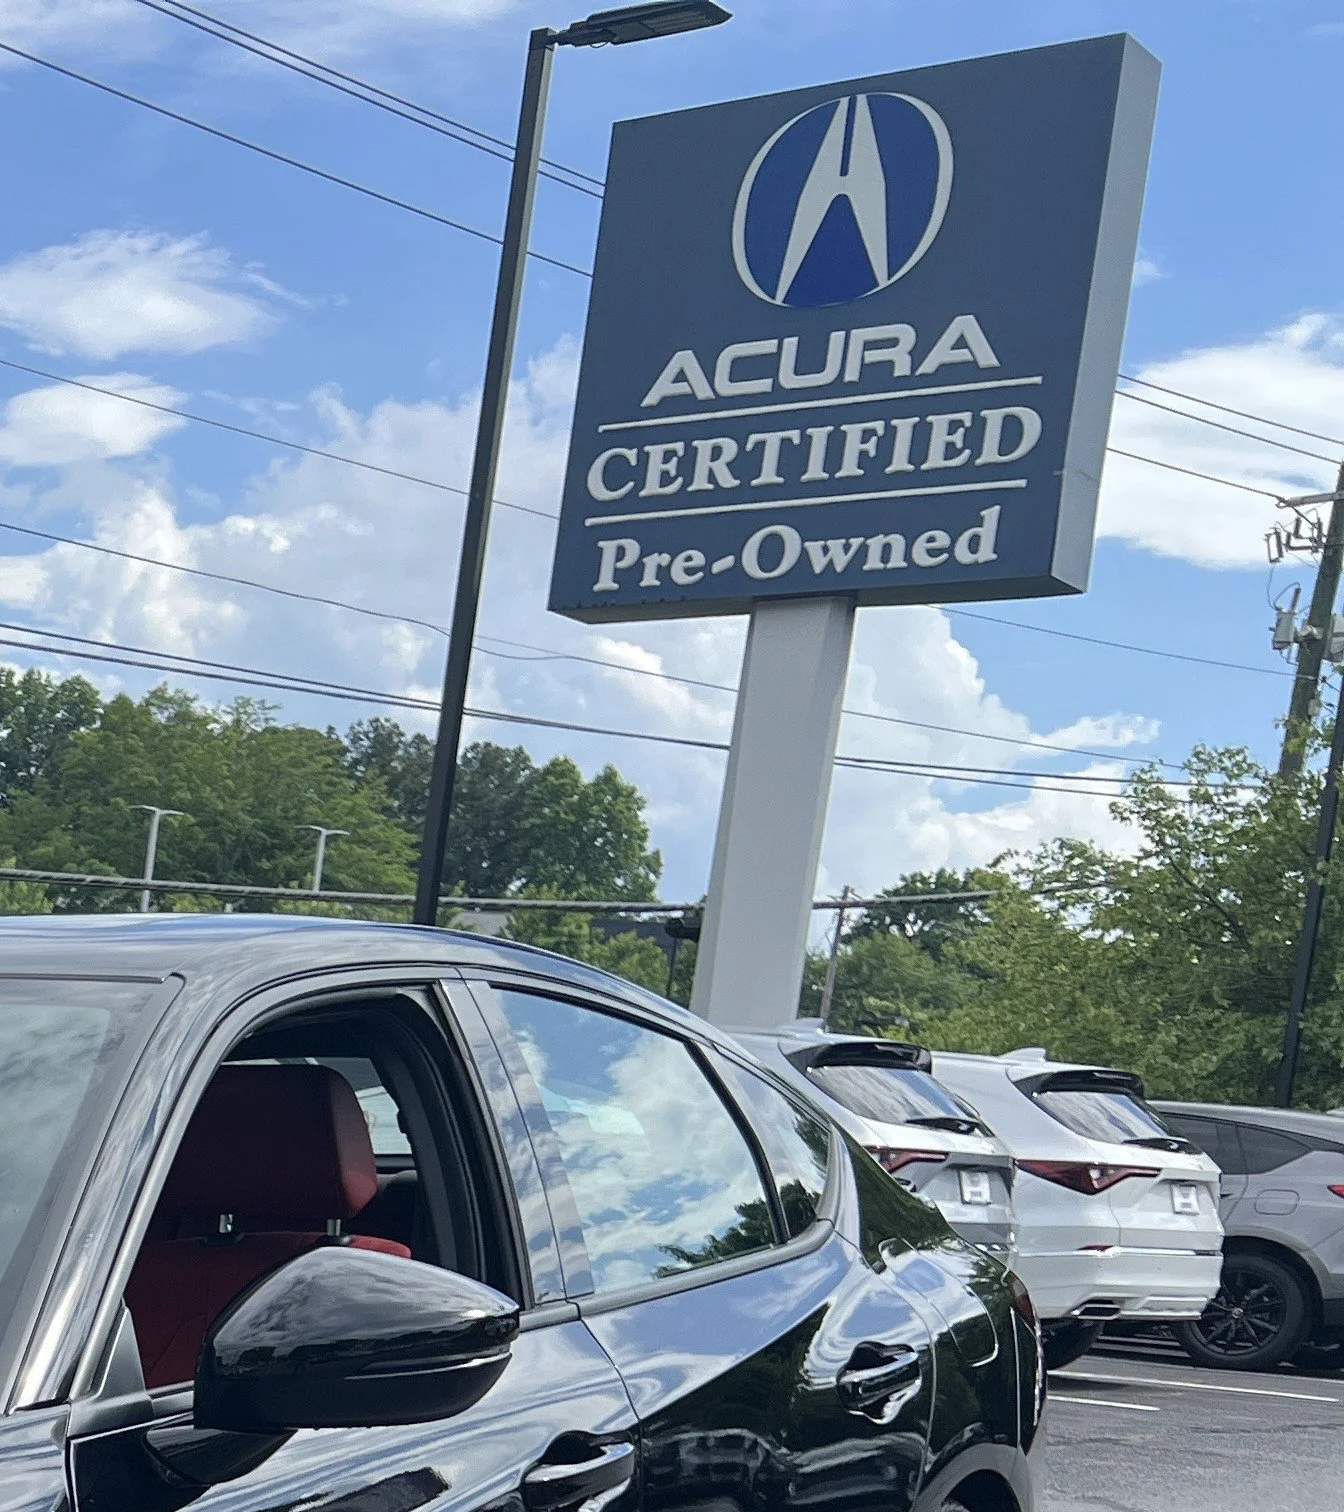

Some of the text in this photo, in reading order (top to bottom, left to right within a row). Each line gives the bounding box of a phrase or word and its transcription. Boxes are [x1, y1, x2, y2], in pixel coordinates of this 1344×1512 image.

[640, 314, 1001, 407] ACURA
[585, 406, 1043, 502] CERTIFIED
[591, 504, 1002, 592] Pre-Owned
